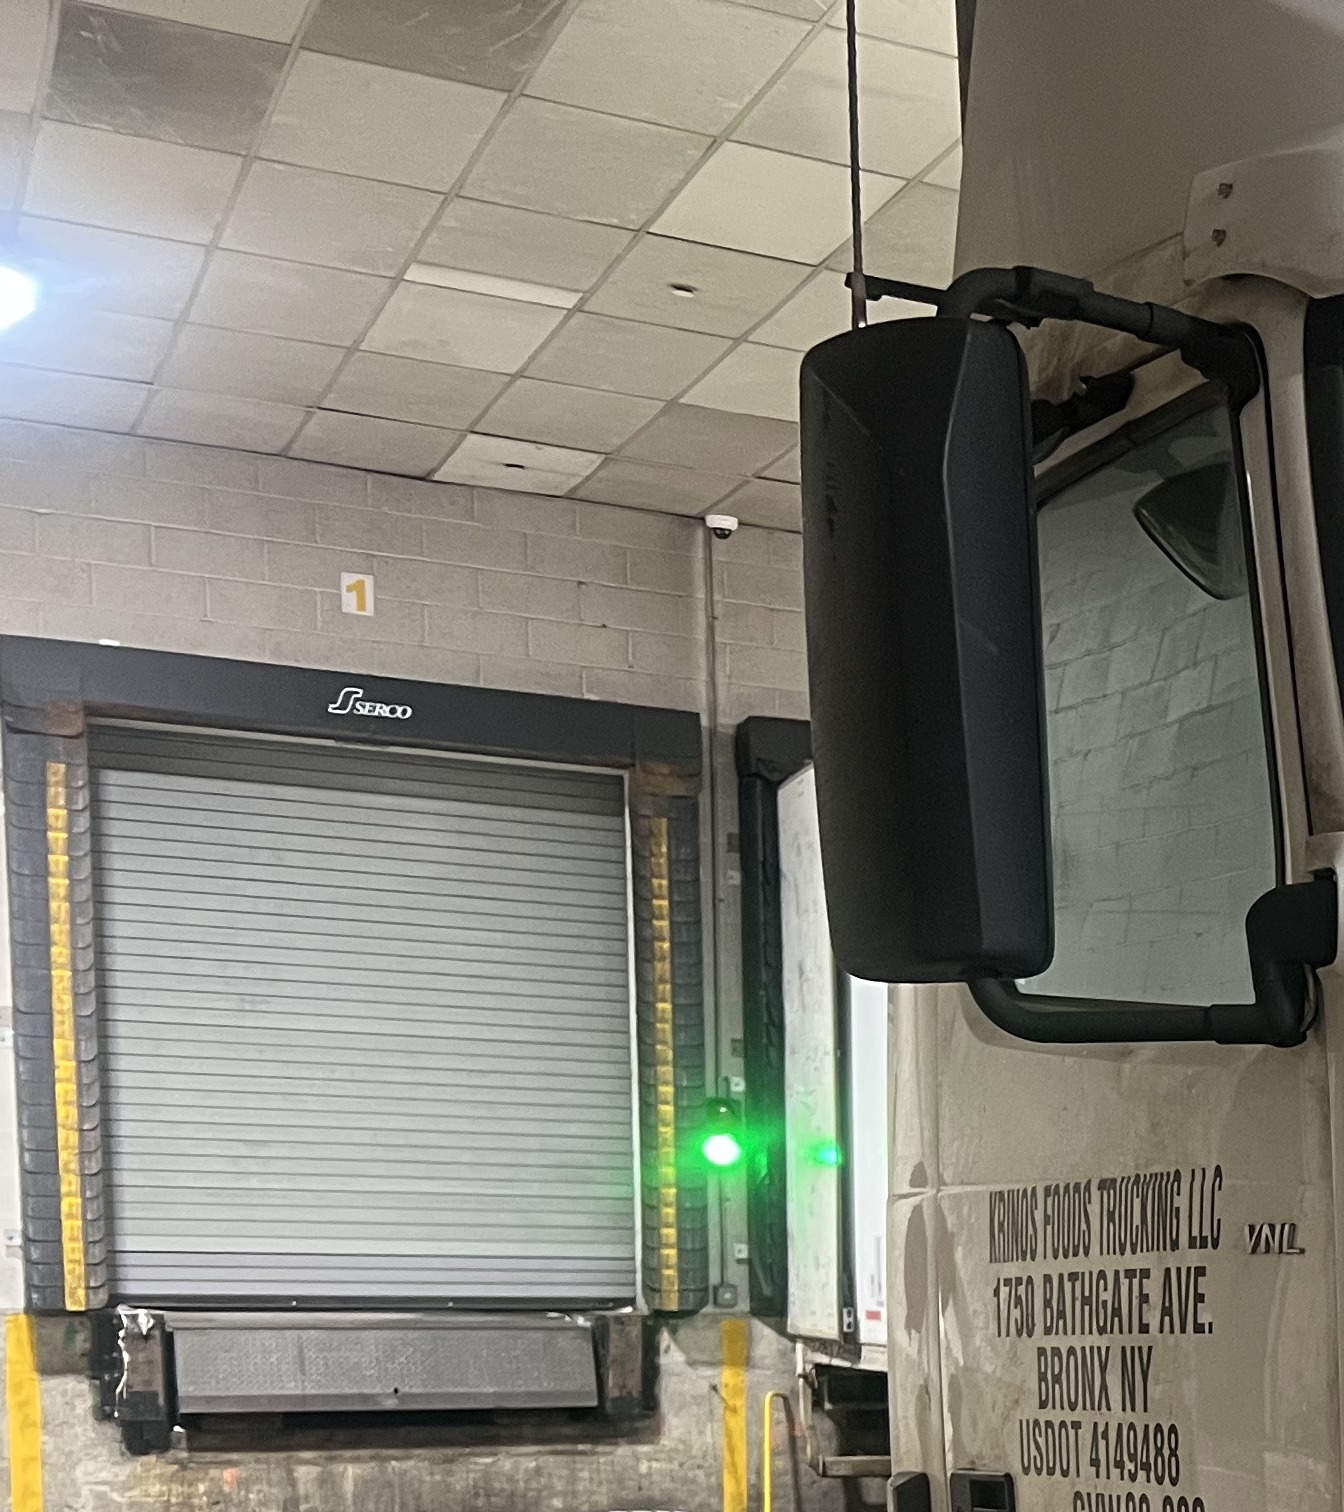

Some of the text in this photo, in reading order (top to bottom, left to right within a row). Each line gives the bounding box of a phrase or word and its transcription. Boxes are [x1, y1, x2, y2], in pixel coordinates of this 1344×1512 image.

[345, 579, 367, 612] 1
[988, 1164, 1223, 1264] KRINOS FOODS TRUCKING LLC
[1244, 1222, 1306, 1255] VNL
[993, 1266, 1214, 1338] 1750 BATHGATE AVE.
[1036, 1345, 1153, 1413] BRONX NY
[1019, 1418, 1181, 1487] USDOT 4149488
